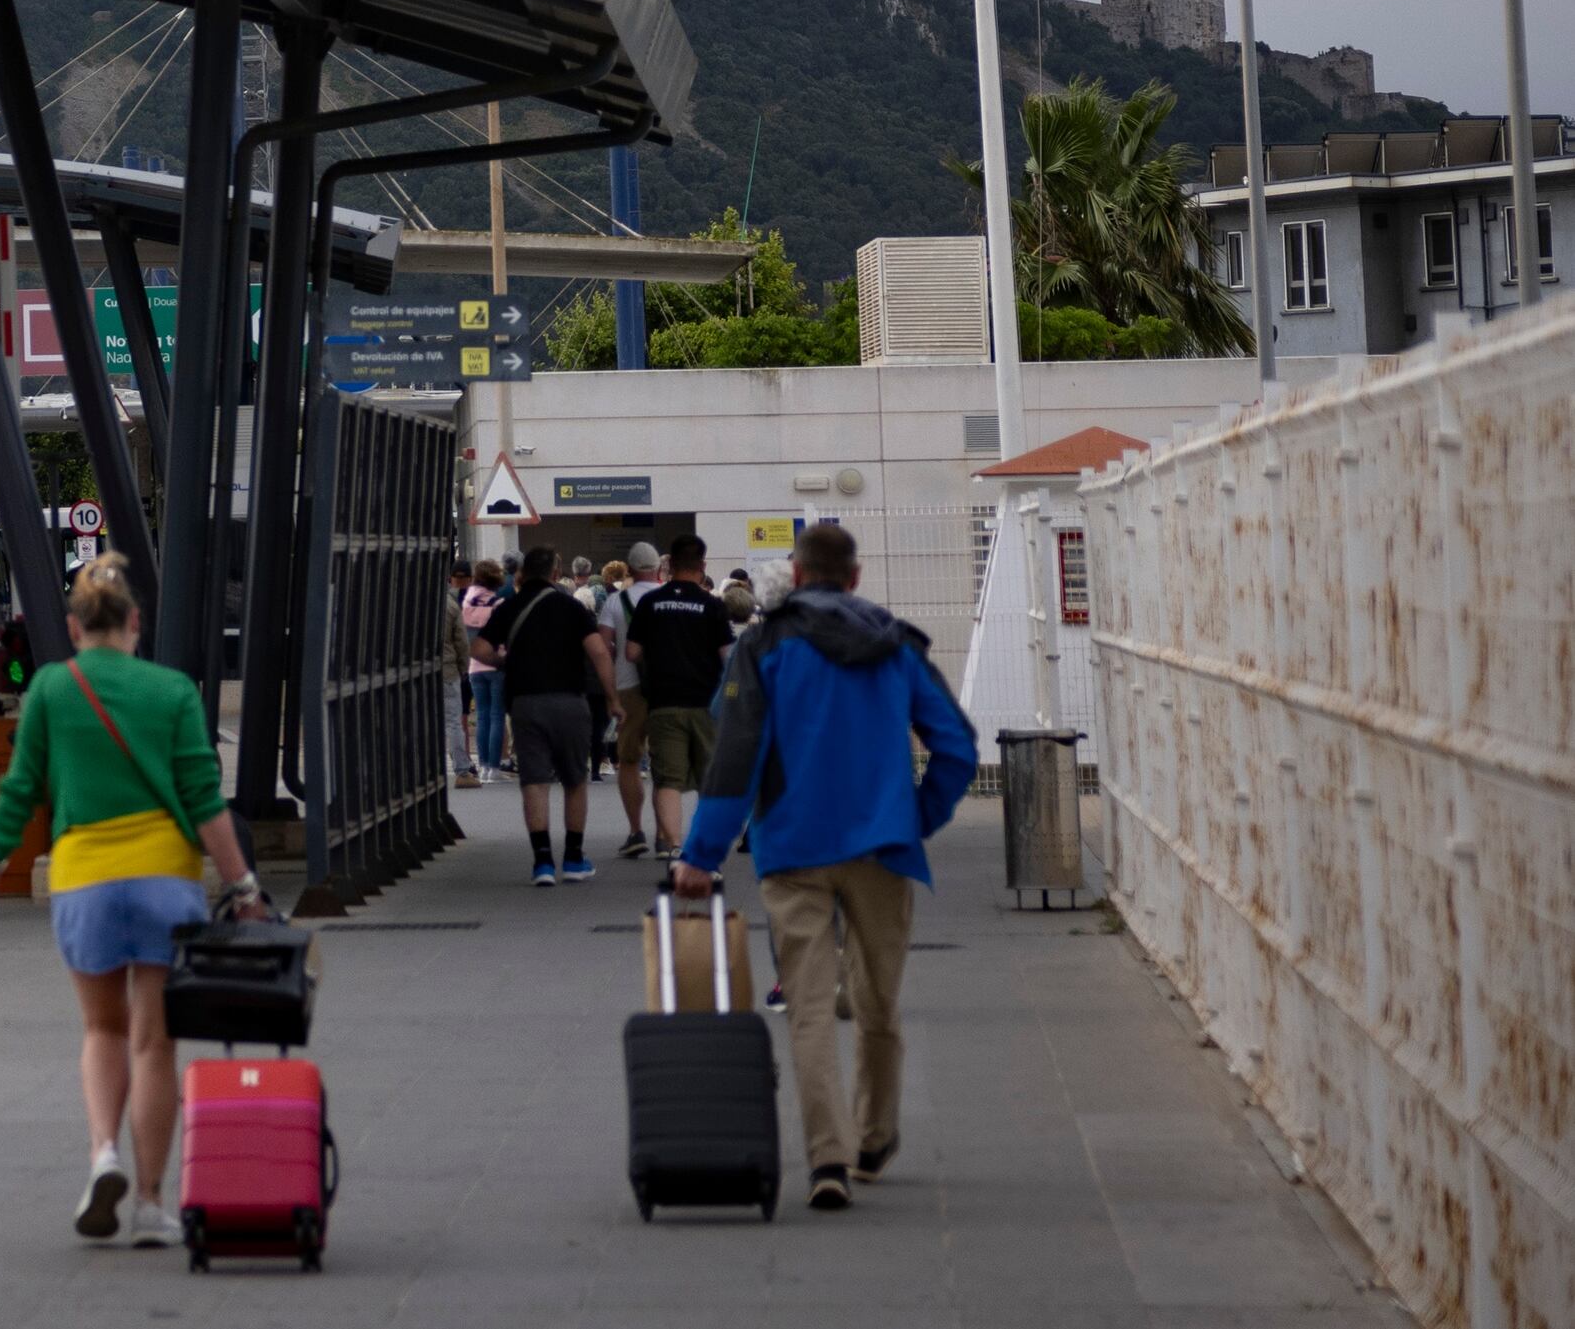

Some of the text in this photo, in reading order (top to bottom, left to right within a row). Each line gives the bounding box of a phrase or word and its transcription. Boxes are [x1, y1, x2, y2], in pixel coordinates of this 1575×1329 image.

[350, 305, 455, 317] Control de equipajes
[351, 351, 444, 361] Devolución de IVA
[468, 353, 483, 362] IVA
[467, 363, 484, 371] VAT
[76, 509, 98, 525] 10
[653, 600, 705, 613] PETRONAS
